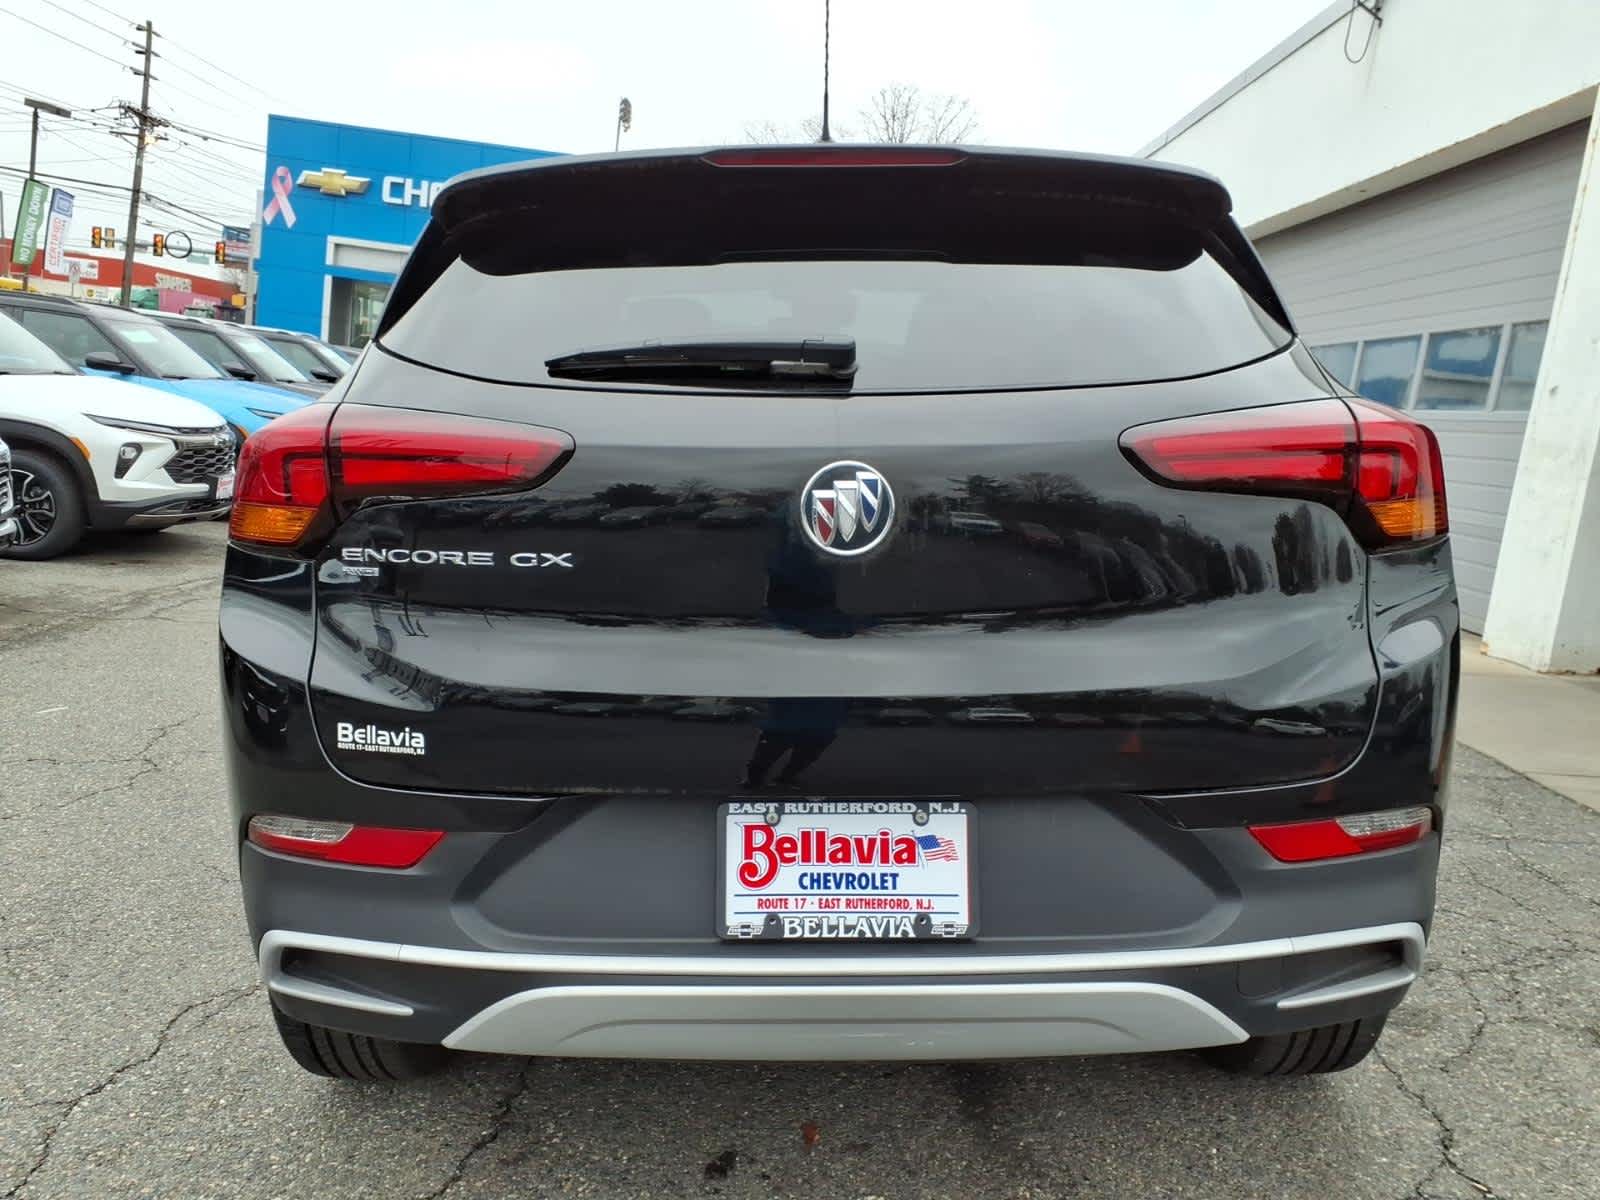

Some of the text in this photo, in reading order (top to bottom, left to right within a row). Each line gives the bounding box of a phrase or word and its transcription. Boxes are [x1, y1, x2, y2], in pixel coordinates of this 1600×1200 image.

[19, 186, 43, 262] NO MONEY DOWN
[342, 547, 574, 568] ENCORE GX
[337, 722, 425, 748] Bellavia
[728, 802, 778, 814] EAST
[928, 802, 967, 814] N.J.
[736, 822, 919, 890] Bellavia
[798, 872, 900, 890] CHEVROLET
[757, 898, 789, 909] ROUTE
[794, 898, 805, 909] 17
[818, 898, 841, 910] EAST
[845, 898, 912, 911] RUTHERFORD,
[915, 898, 935, 910] N.J.
[783, 916, 916, 938] BELLAVIA
